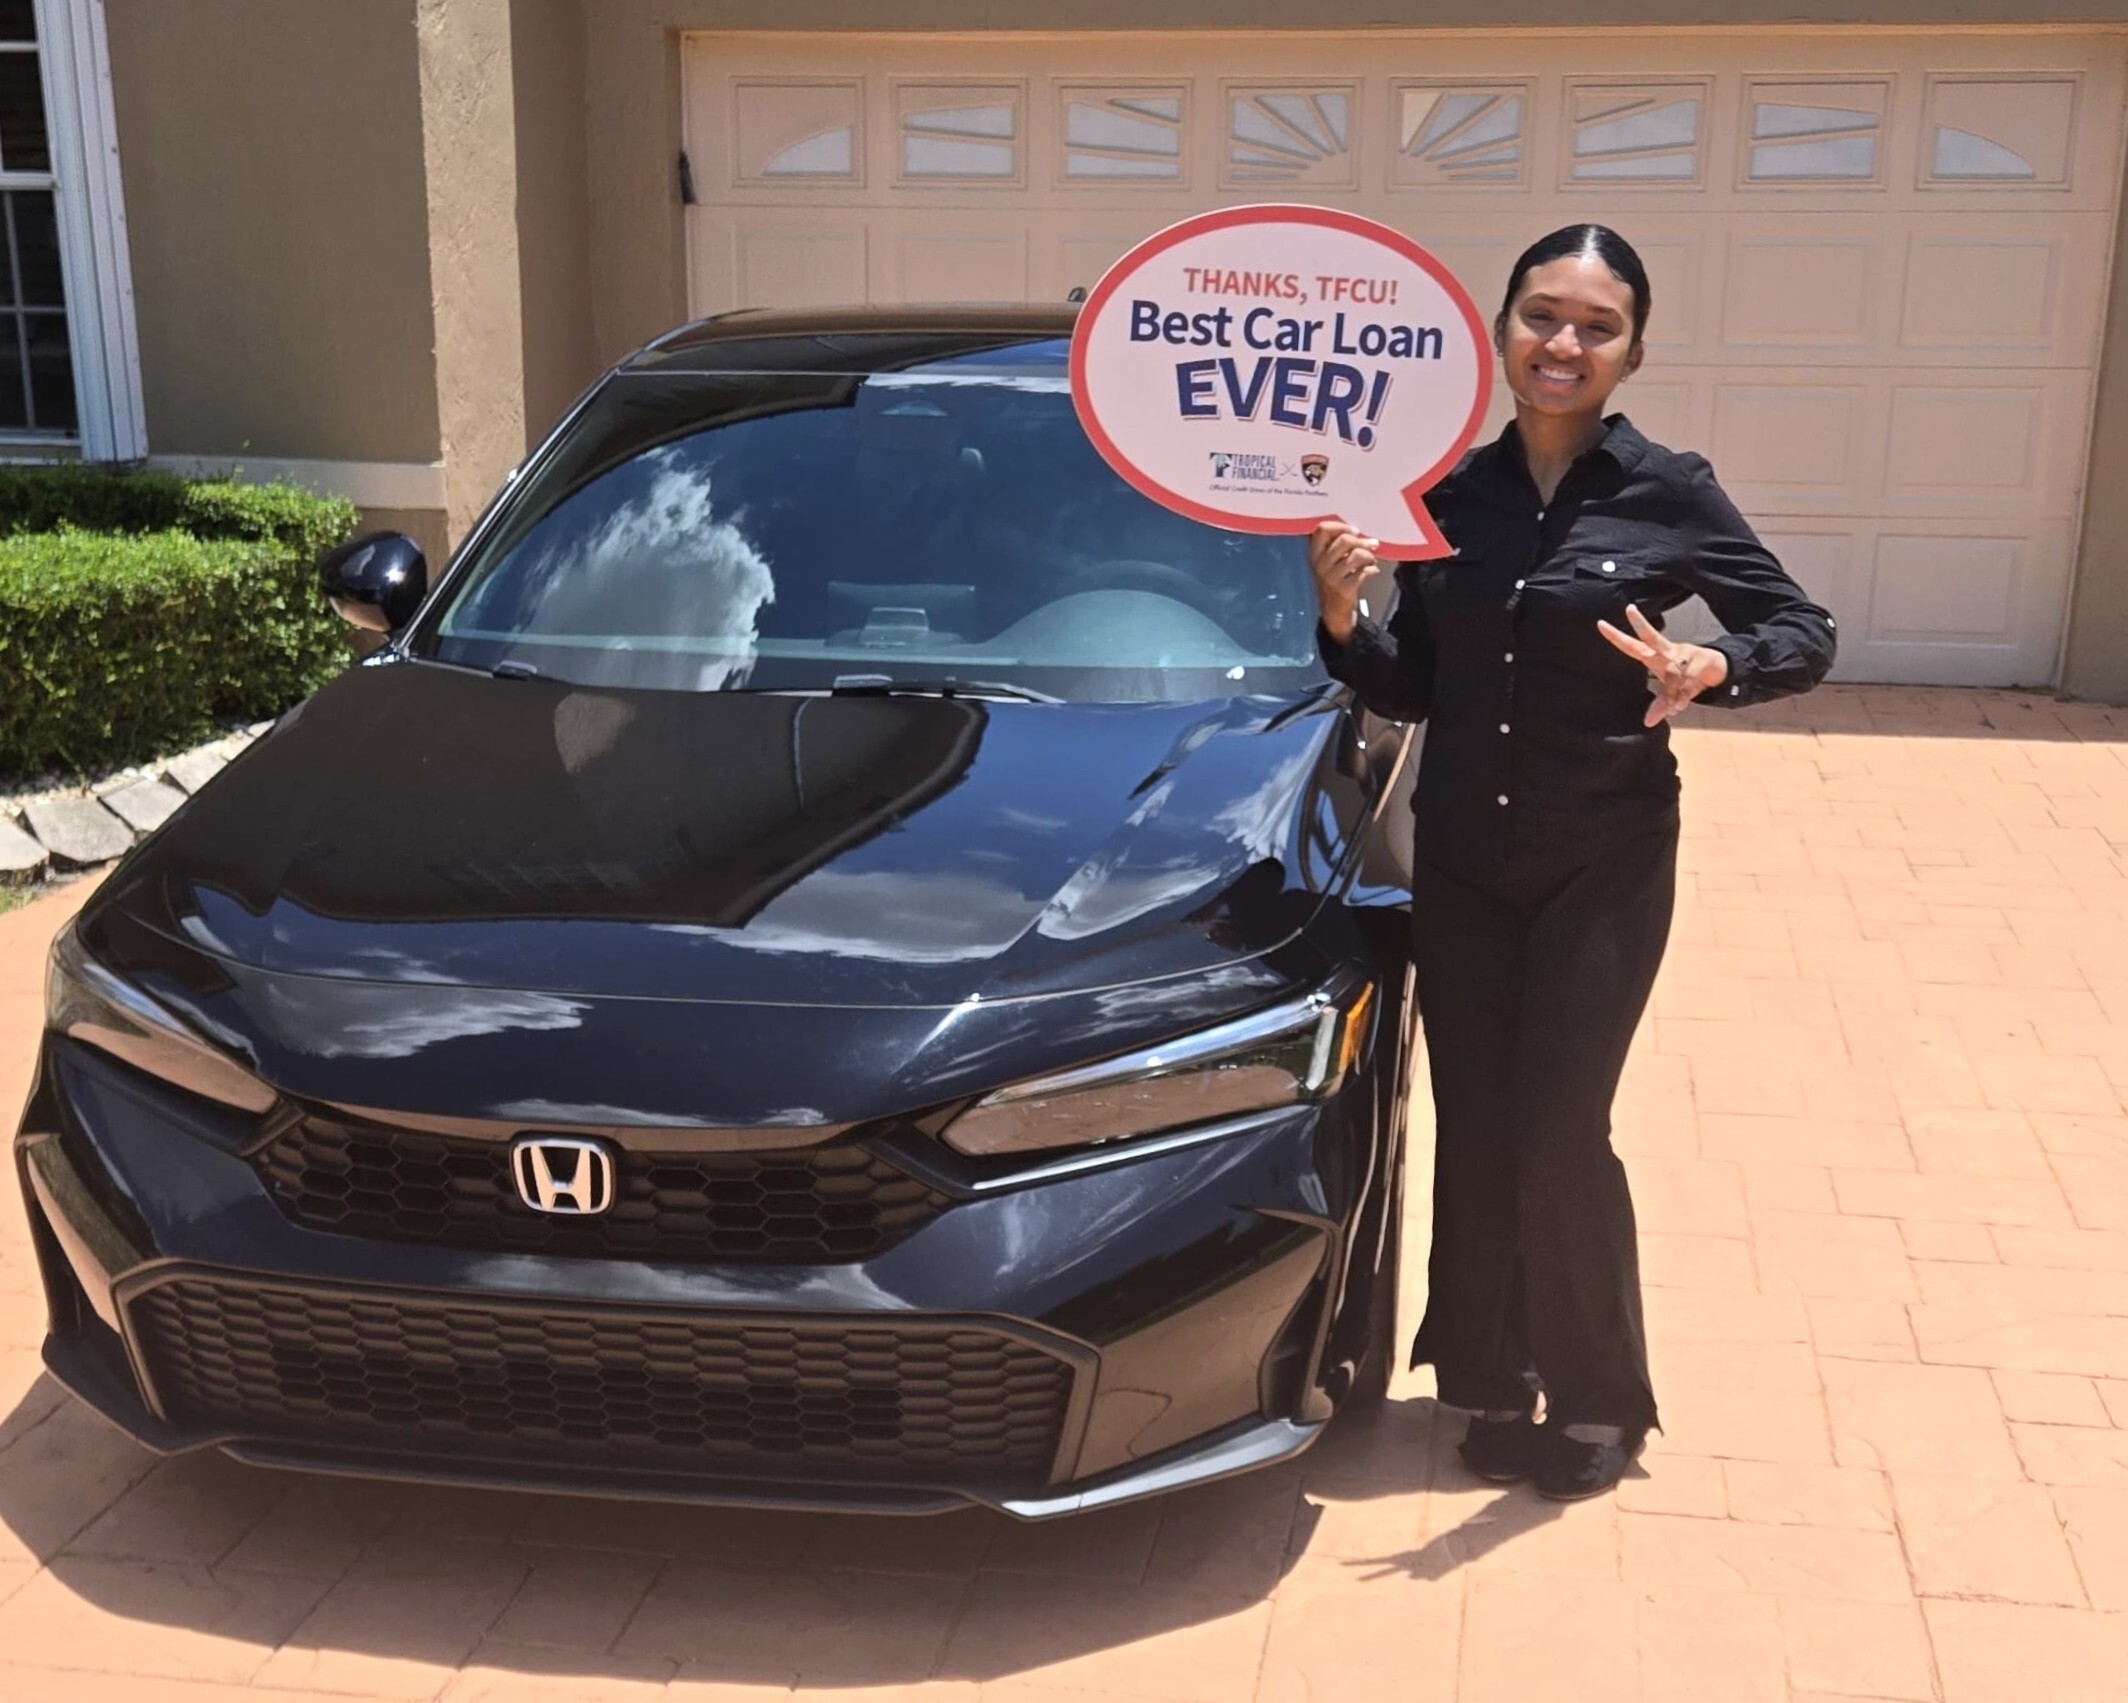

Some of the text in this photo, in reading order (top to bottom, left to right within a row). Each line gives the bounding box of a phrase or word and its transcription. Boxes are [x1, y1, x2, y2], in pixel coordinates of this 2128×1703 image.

[1183, 267, 1398, 305] THANKS, TFCU!
[1130, 300, 1443, 359] Best Car Loan
[1175, 356, 1393, 452] EVER!
[1231, 454, 1276, 467] TROPICAL
[1231, 466, 1278, 481] FINANCIAL
